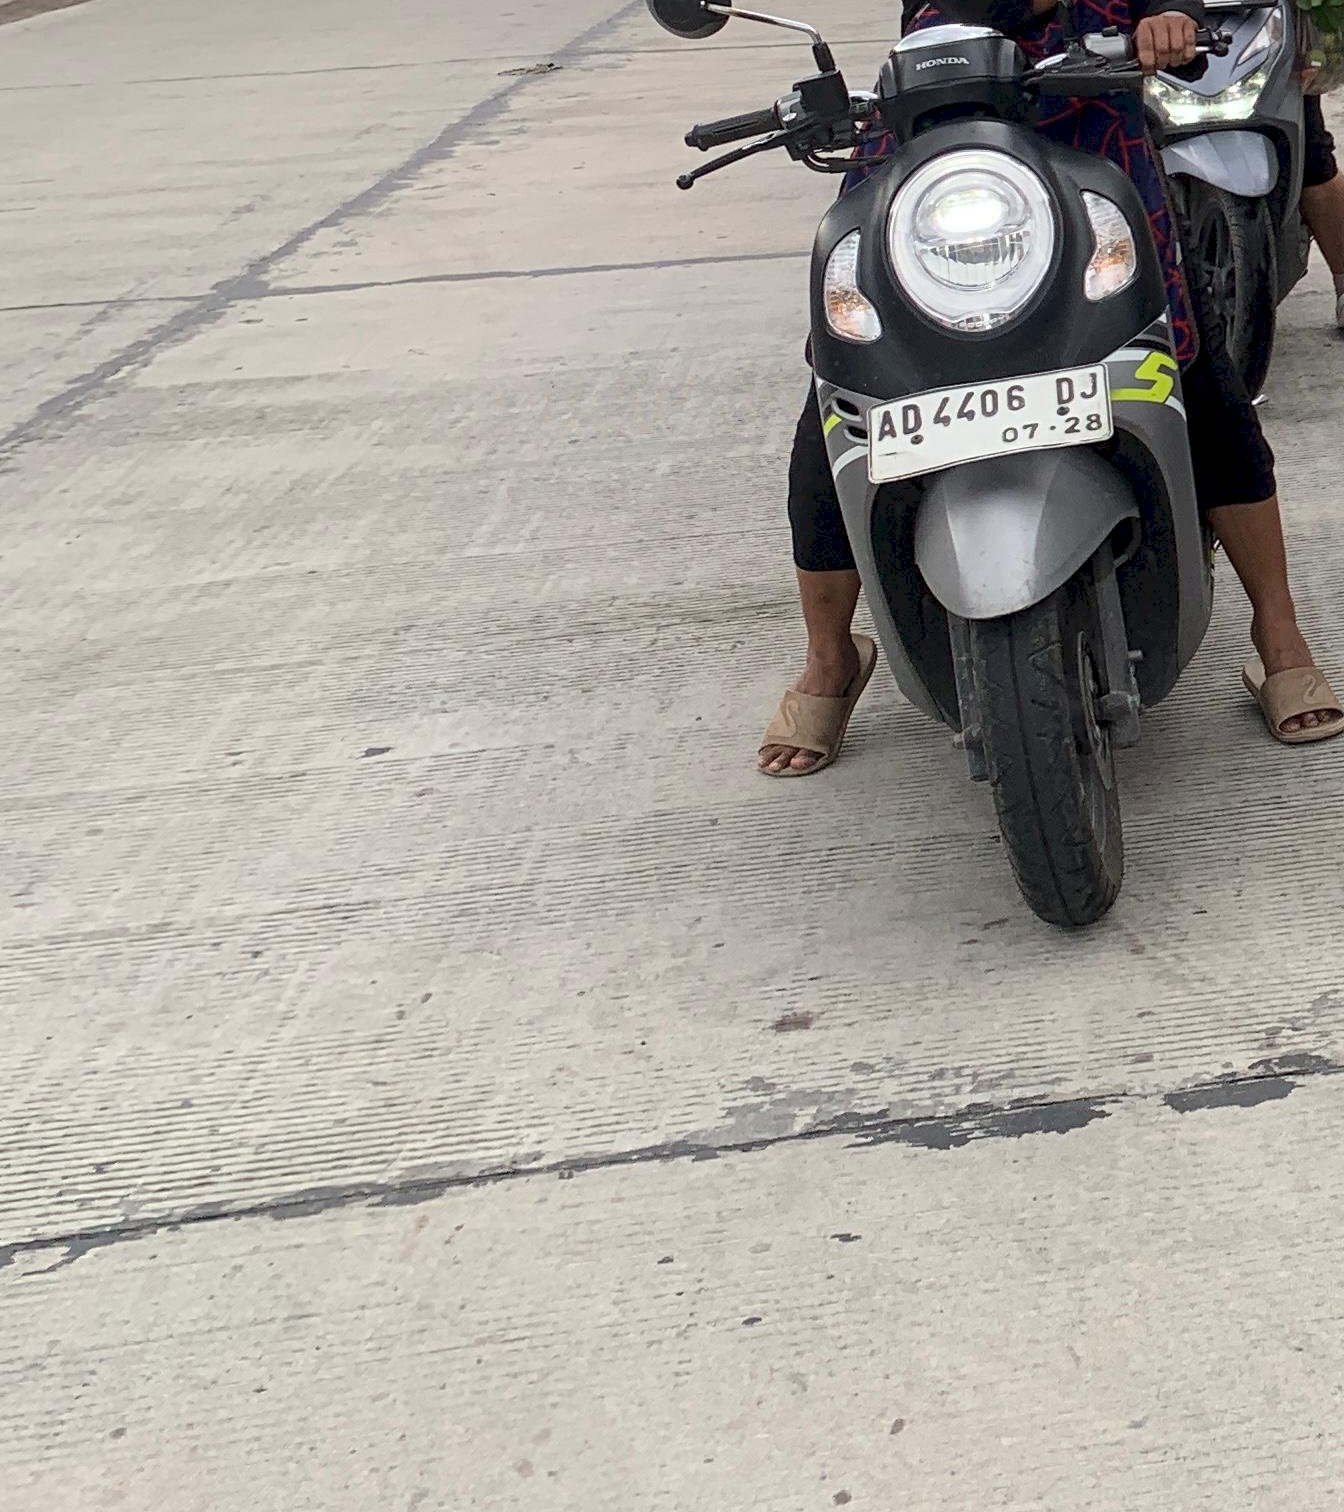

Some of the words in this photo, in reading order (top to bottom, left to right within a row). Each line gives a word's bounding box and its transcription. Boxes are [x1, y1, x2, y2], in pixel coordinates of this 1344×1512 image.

[915, 57, 970, 71] HONDA
[877, 404, 923, 442] AD
[932, 384, 1026, 427] 4406
[1055, 372, 1098, 406] DJ
